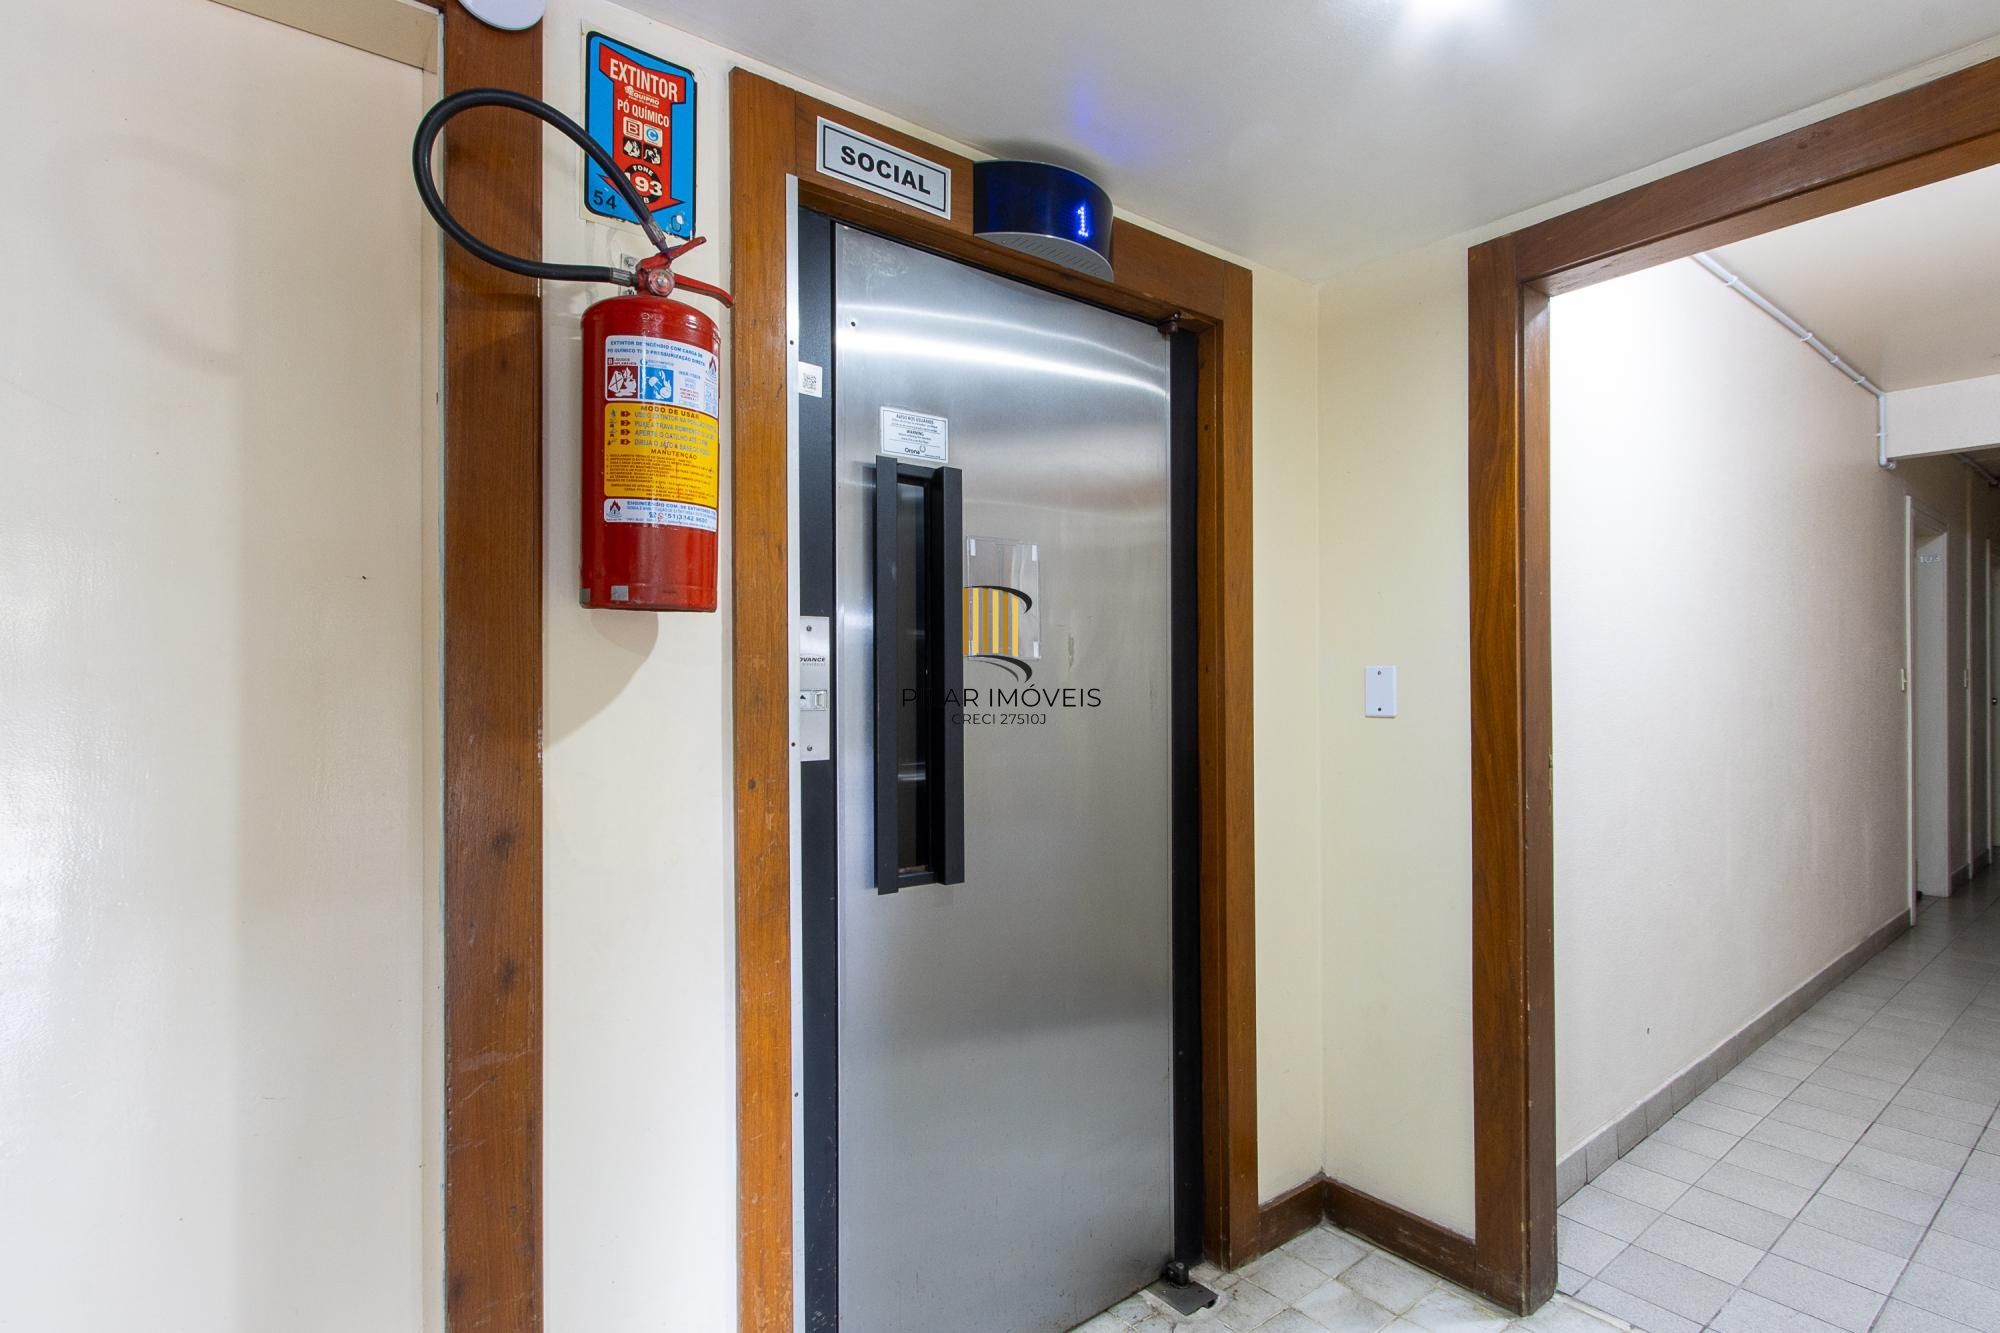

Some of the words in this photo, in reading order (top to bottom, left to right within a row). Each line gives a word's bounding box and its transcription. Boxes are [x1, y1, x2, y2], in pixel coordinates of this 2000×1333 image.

[609, 58, 678, 103] EXTINTOR
[617, 98, 630, 114] PÓ
[632, 103, 670, 128] QUÍMICO
[627, 121, 639, 137] B
[646, 128, 659, 143] C
[632, 165, 654, 177] FONE
[841, 145, 931, 196] SOCIAL
[593, 190, 617, 209] 54
[1077, 206, 1089, 238] 1
[650, 448, 698, 460] MANUTENÇÃO
